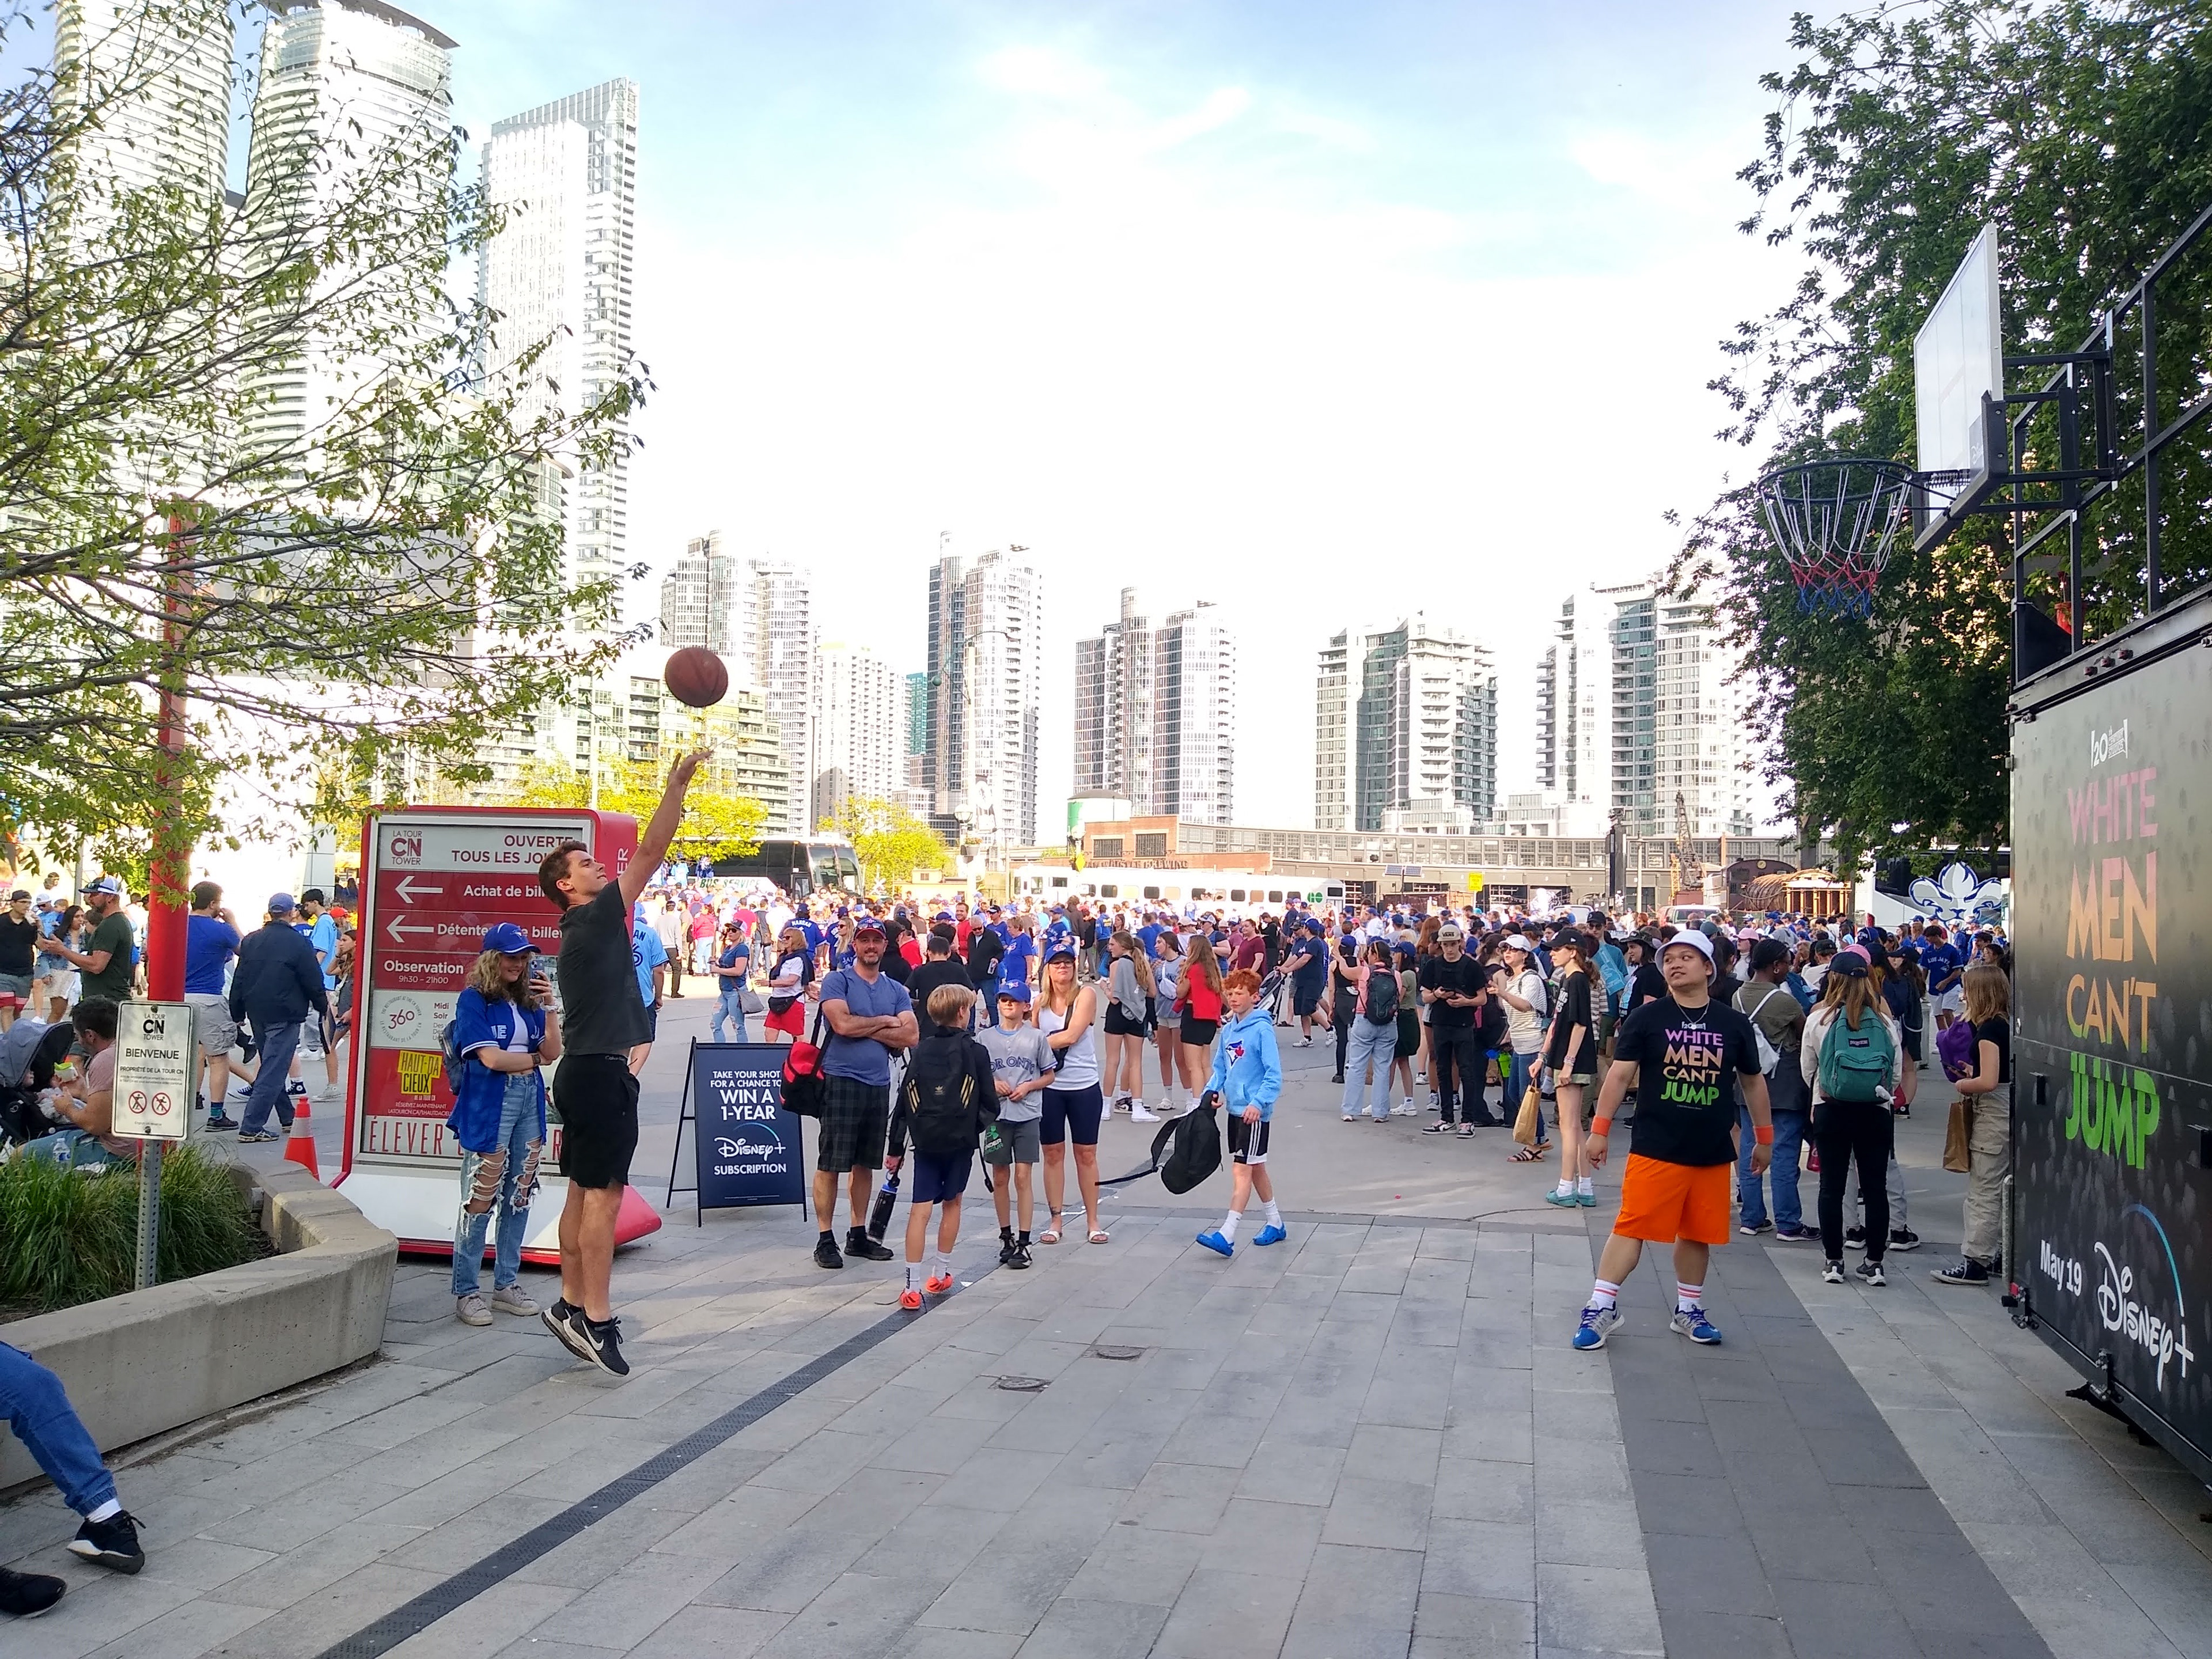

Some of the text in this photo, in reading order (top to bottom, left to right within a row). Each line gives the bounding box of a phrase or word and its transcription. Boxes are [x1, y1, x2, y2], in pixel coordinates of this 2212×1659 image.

[2067, 767, 2158, 846] WHITE
[391, 838, 422, 857] CN
[392, 857, 421, 865] TOWER
[452, 850, 490, 862] TOUS
[495, 851, 520, 863] LES
[1144, 859, 1189, 870] BREWING
[463, 885, 502, 897] Achat
[505, 885, 522, 897] de
[700, 878, 719, 888] BUS
[2066, 850, 2157, 965] MEN
[384, 960, 464, 975] Observation
[388, 1009, 415, 1029] 360
[2066, 974, 2157, 1054] CAN'T
[143, 1019, 165, 1034] CN
[1665, 1029, 1724, 1046] WHITE
[126, 1048, 179, 1059] BIENVENUE
[1664, 1043, 1723, 1069] MEN
[403, 1073, 430, 1093] CIEUX
[713, 1071, 733, 1079] TAKE
[1663, 1066, 1720, 1084] CAN'T
[710, 1080, 727, 1088] FOR
[729, 1080, 735, 1088] A
[737, 1080, 771, 1088] CHANCE
[720, 1089, 774, 1104] WIN A
[1661, 1081, 1719, 1105] JUMP
[721, 1105, 776, 1120] 1-YEAR
[2066, 1051, 2160, 1169] JUMP
[369, 1116, 443, 1154] ÉLEVER
[714, 1164, 787, 1175] SUBSCRIPTION
[2040, 1239, 2082, 1296] May 19
